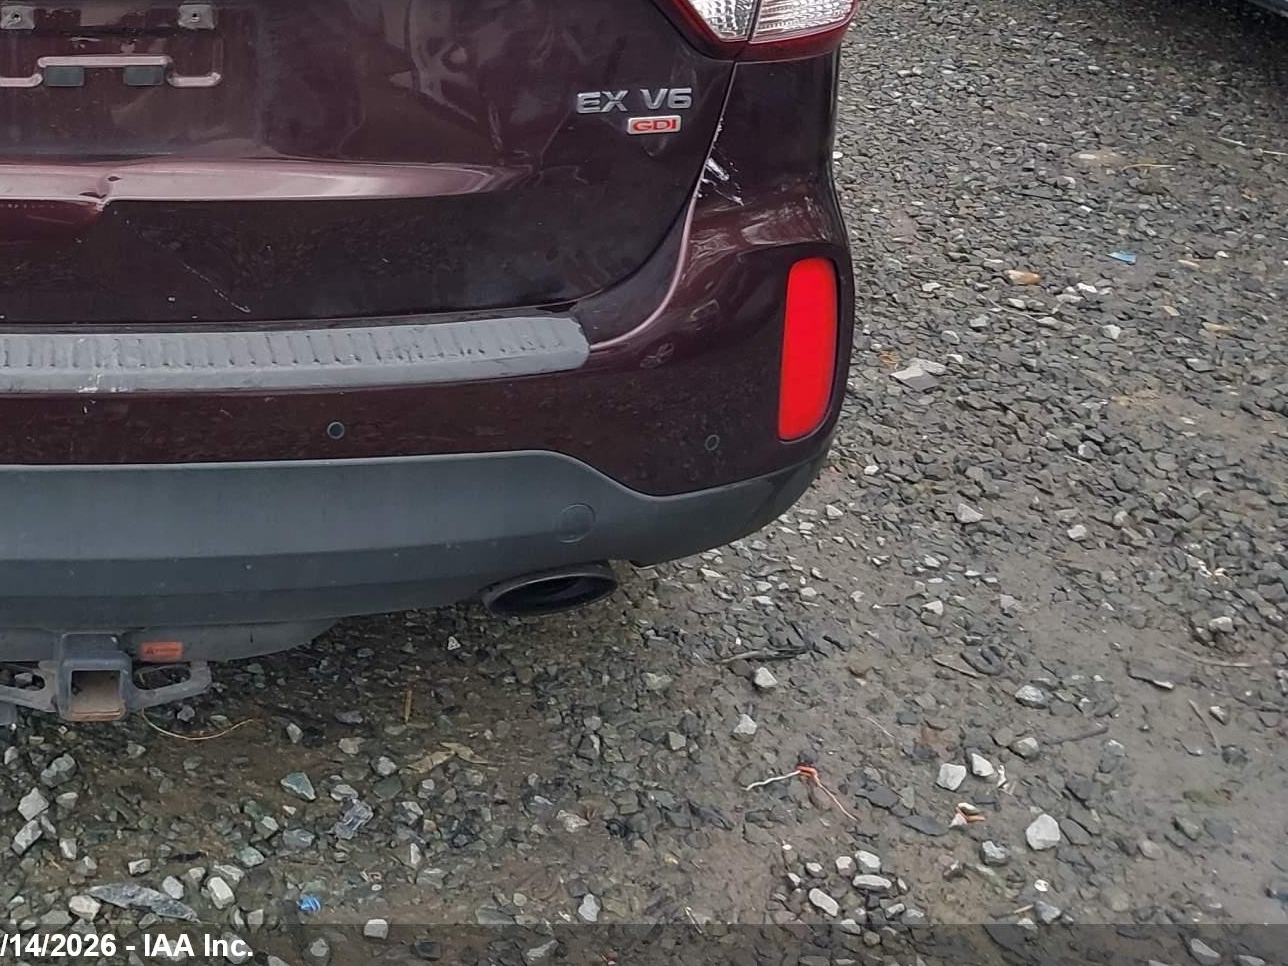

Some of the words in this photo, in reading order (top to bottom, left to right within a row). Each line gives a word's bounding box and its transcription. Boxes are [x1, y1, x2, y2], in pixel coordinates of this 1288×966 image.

[576, 90, 629, 114] EX
[639, 87, 693, 110] V6
[632, 119, 677, 132] GDI
